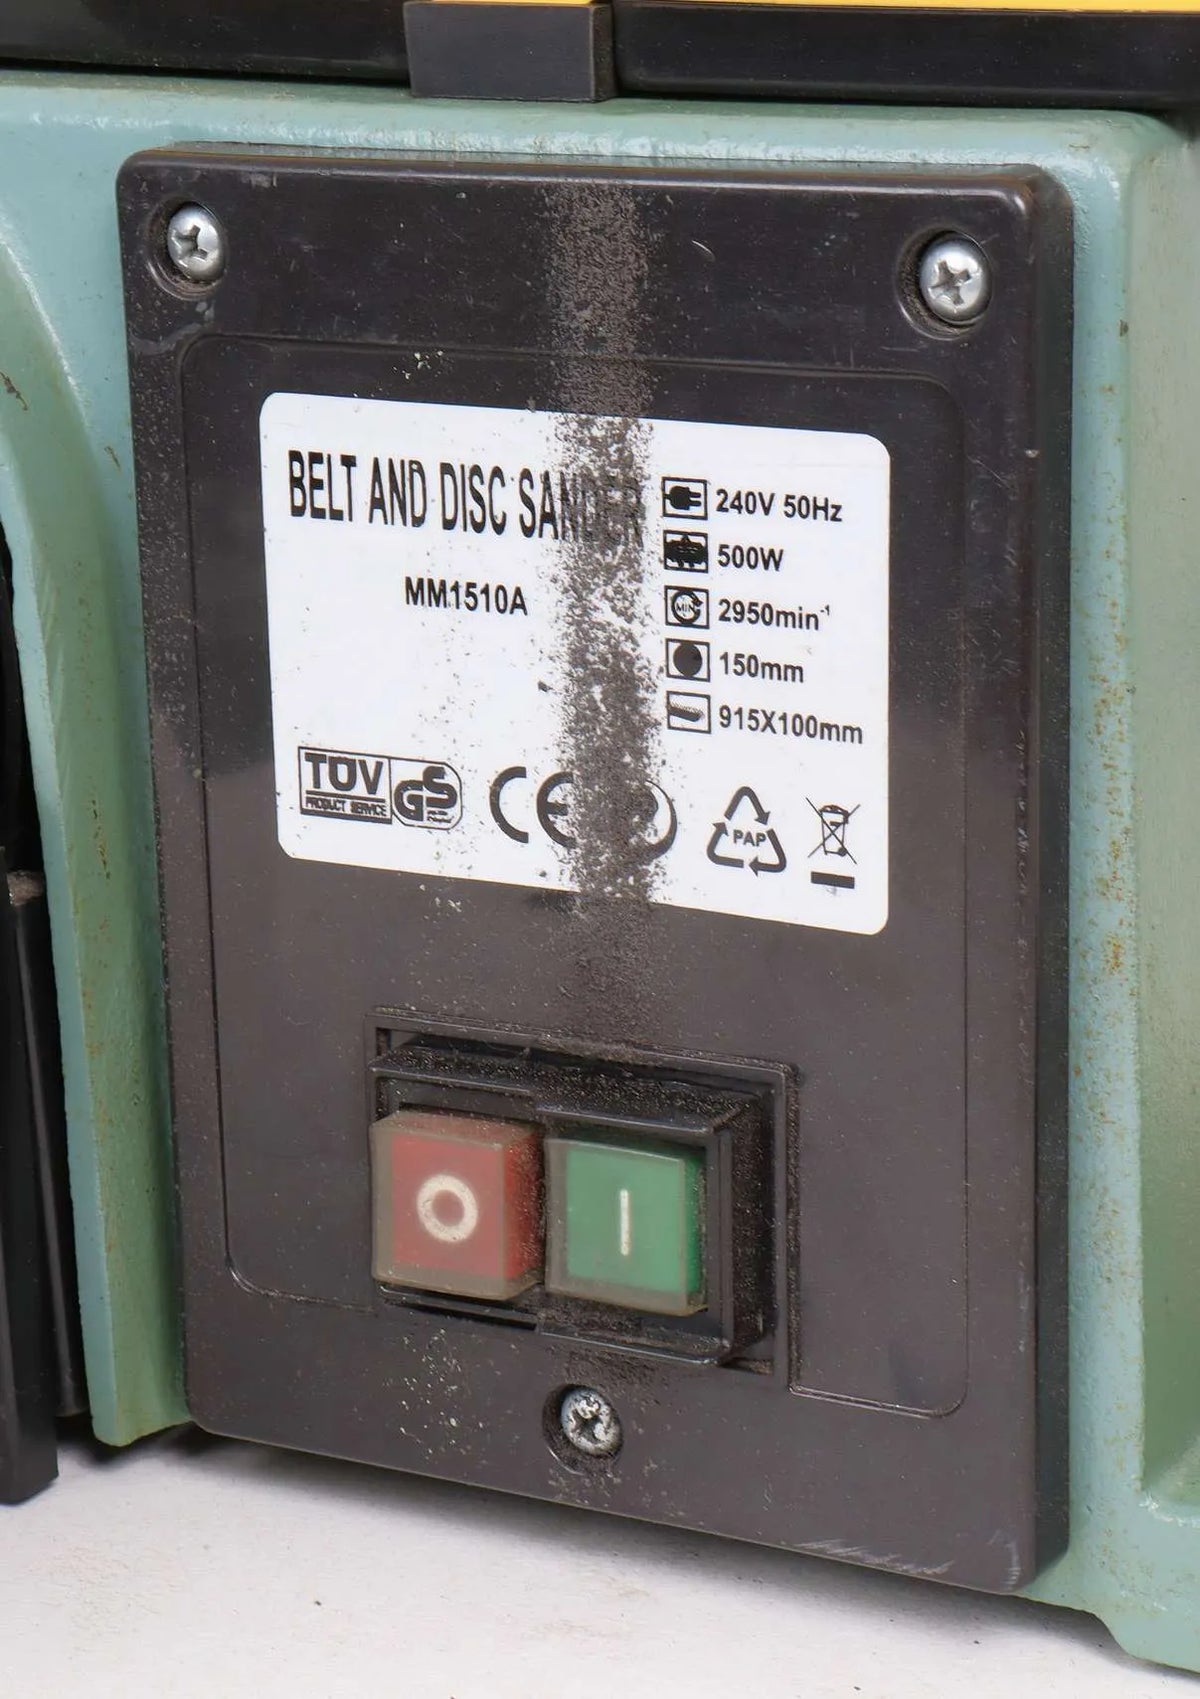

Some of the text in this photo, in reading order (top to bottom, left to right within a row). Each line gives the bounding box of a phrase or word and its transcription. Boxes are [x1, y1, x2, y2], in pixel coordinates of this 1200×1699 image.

[288, 450, 357, 522] BELT
[368, 456, 427, 528] AND
[440, 463, 506, 536] DISC
[716, 488, 843, 523] 240V 50Hz
[717, 544, 784, 572] 500W
[405, 576, 528, 616] MM1510A
[719, 651, 804, 683] 150mm
[719, 704, 863, 745] 915X100mm
[393, 765, 458, 822] GS
[733, 829, 766, 847] PAP
